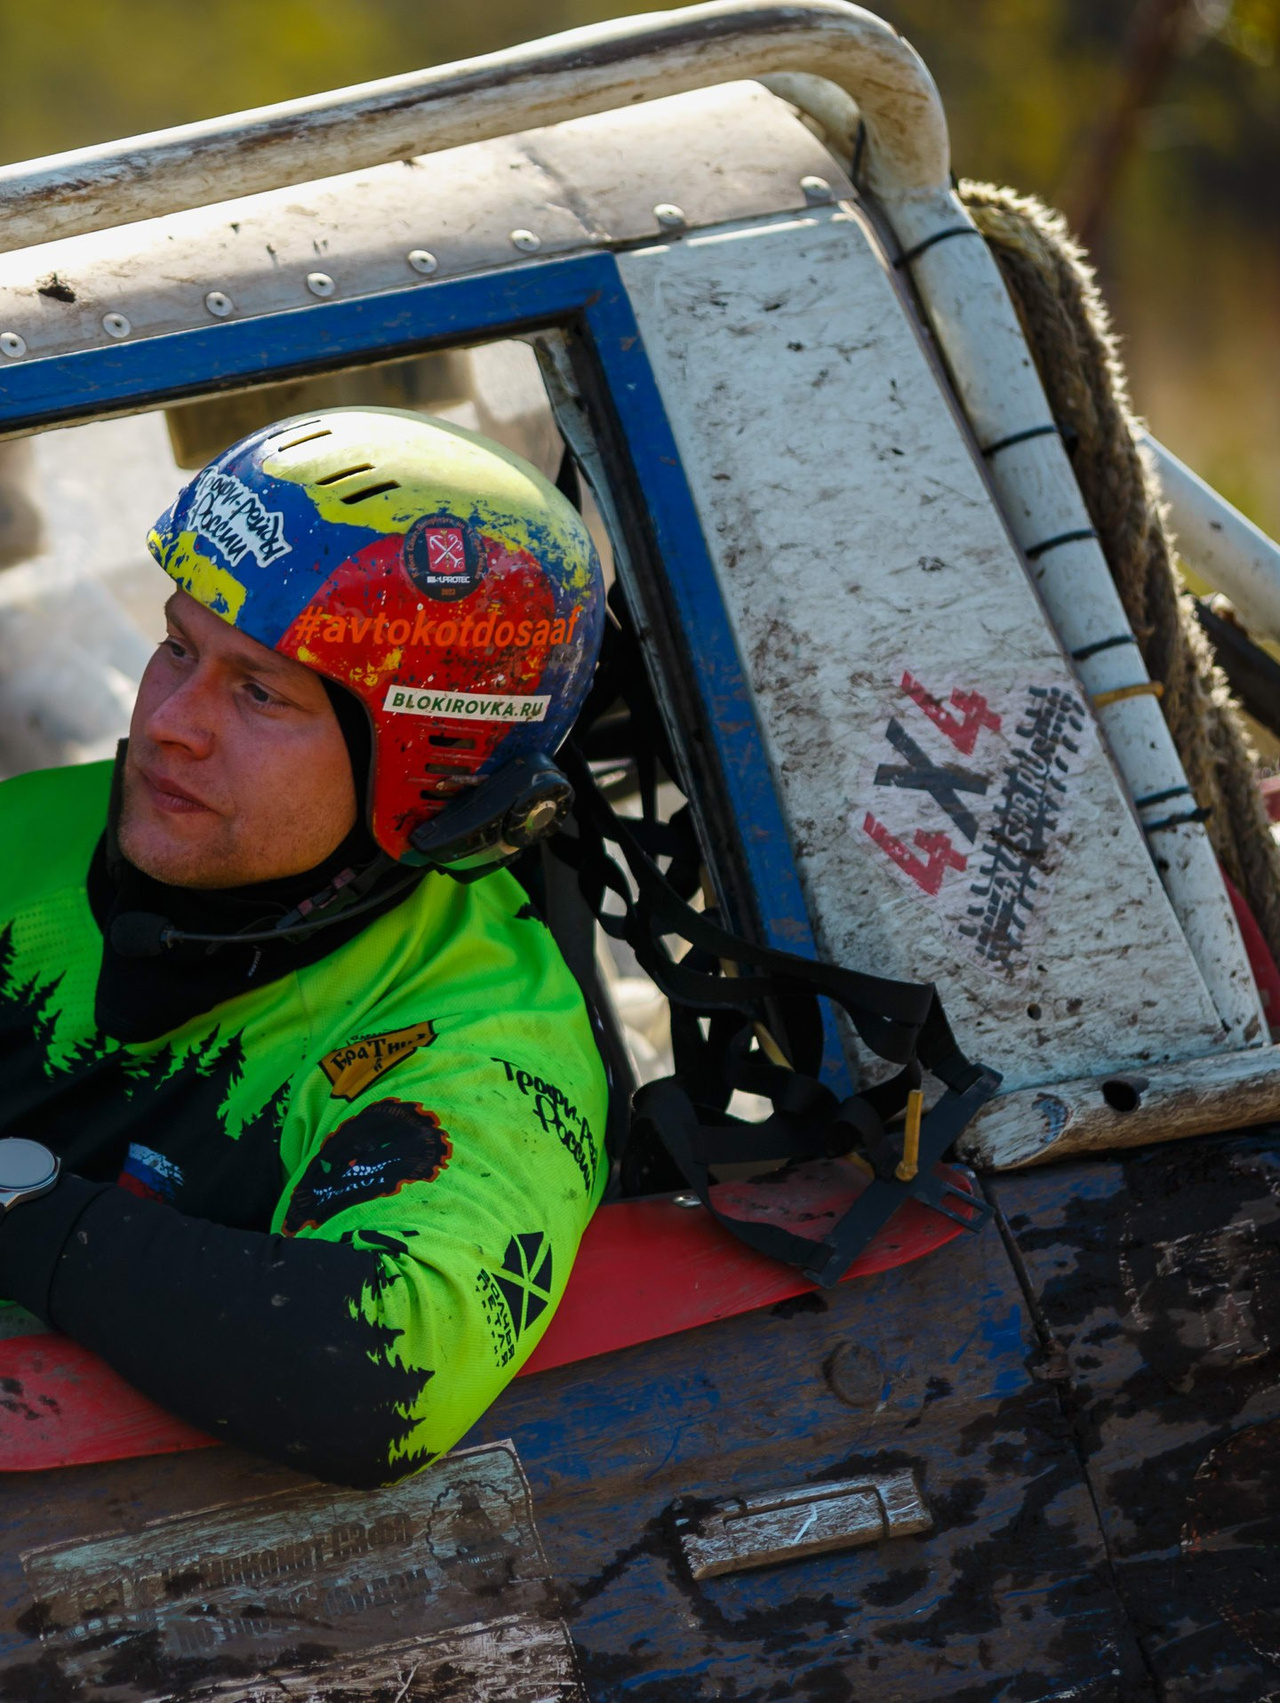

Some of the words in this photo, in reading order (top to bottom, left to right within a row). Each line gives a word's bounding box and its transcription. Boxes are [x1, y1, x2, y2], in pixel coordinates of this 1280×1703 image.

[190, 492, 248, 561] России
[293, 605, 584, 648] #avtokotdosaaf
[391, 692, 544, 718] BLOKIROVKA.RU
[863, 670, 1002, 897] 4X4
